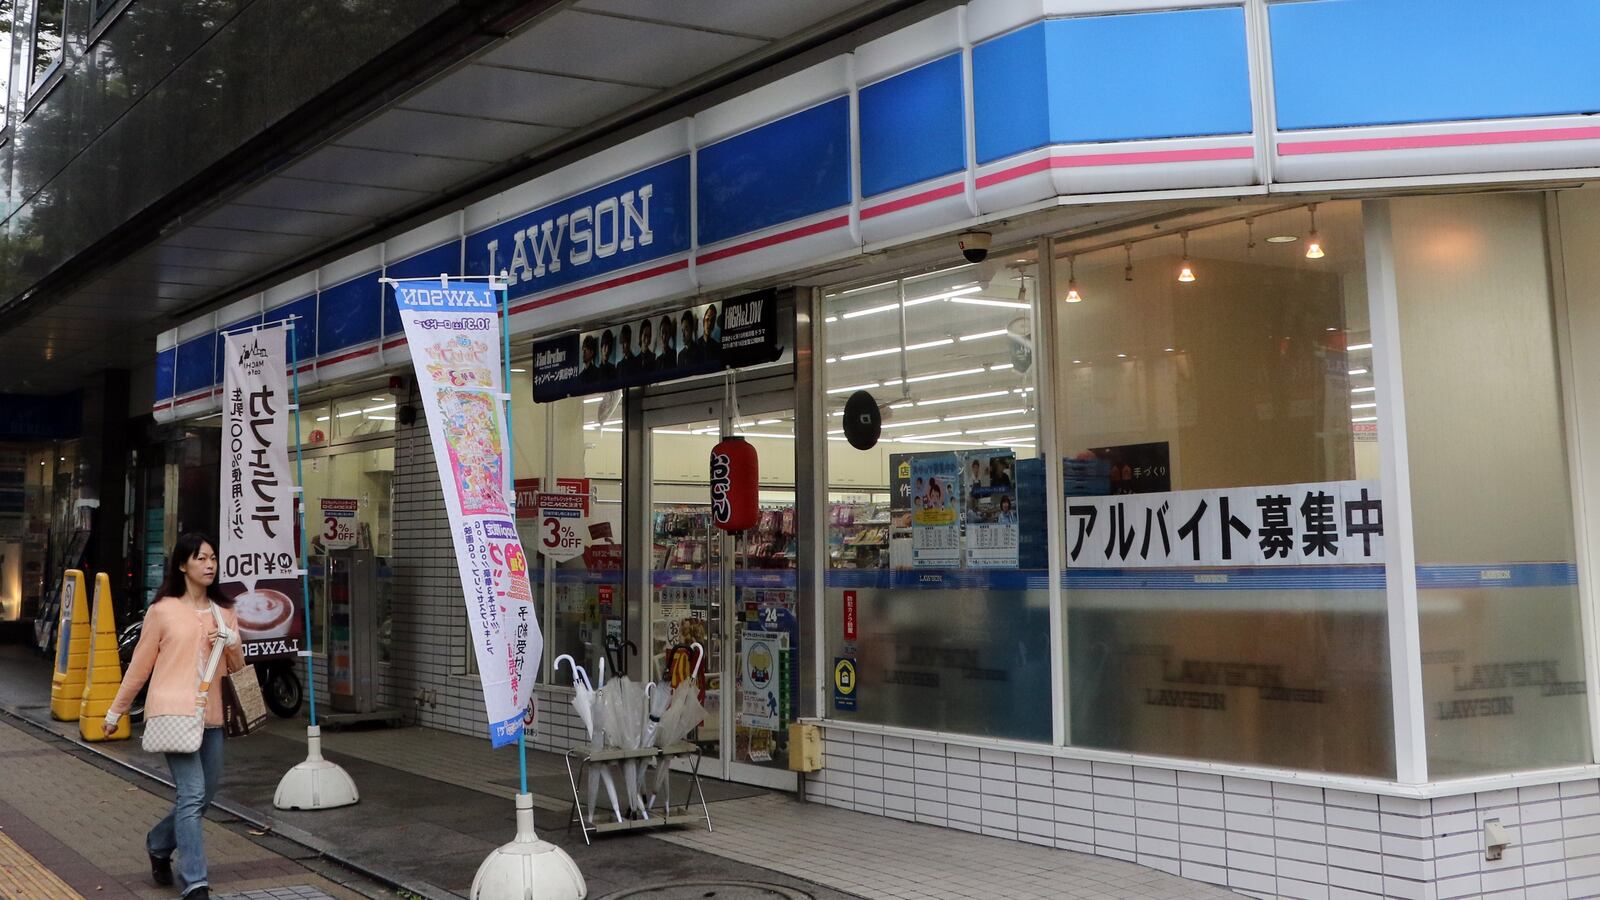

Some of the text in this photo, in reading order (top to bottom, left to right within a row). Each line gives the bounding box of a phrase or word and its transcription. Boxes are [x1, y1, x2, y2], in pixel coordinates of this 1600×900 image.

[487, 184, 653, 288] LAWSON
[516, 490, 538, 508] ATM
[1069, 488, 1384, 562] アルバイト募集中
[338, 532, 354, 541] OFF
[561, 538, 582, 549] OFF
[765, 608, 778, 622] 24
[1144, 688, 1226, 711] LAWSON
[1438, 695, 1514, 720] LAWSON
